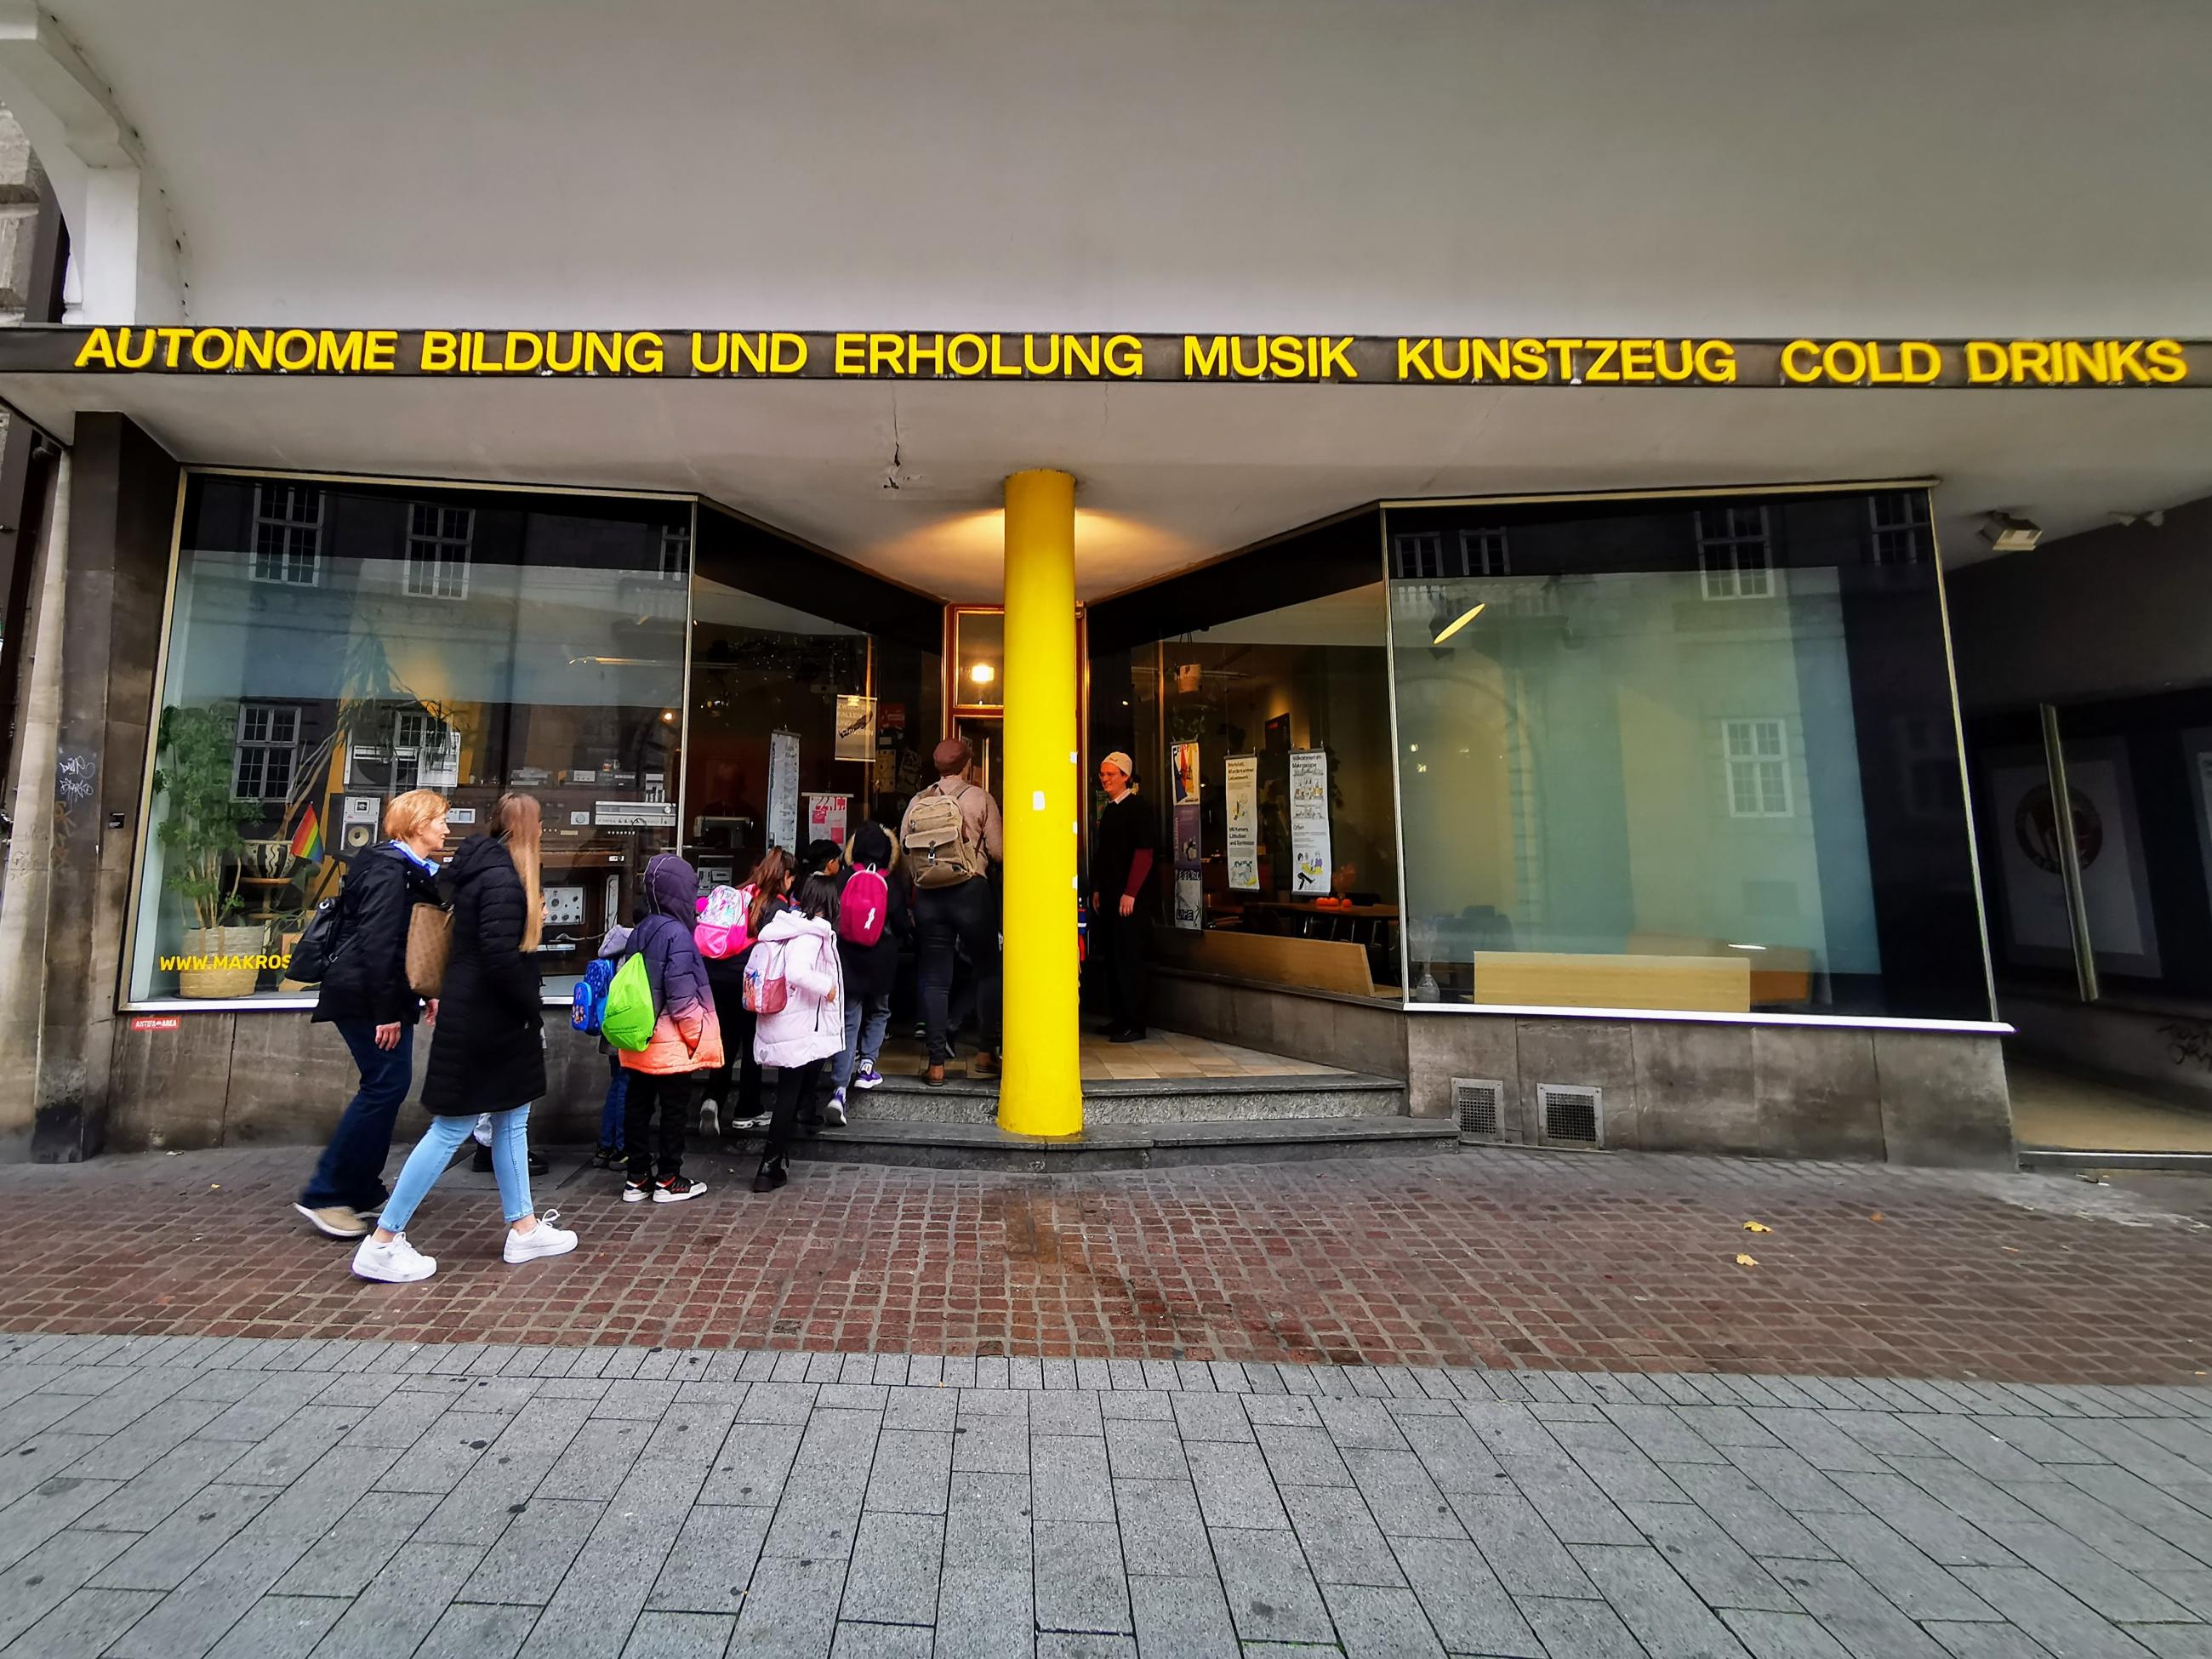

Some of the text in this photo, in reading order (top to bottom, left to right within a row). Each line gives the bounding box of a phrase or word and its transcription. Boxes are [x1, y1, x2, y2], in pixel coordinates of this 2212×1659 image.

[74, 328, 2188, 384] AUTONOME BILDUNG UND ERHOLUNG MUSIK KUNSTZEUG COLD DRINKS
